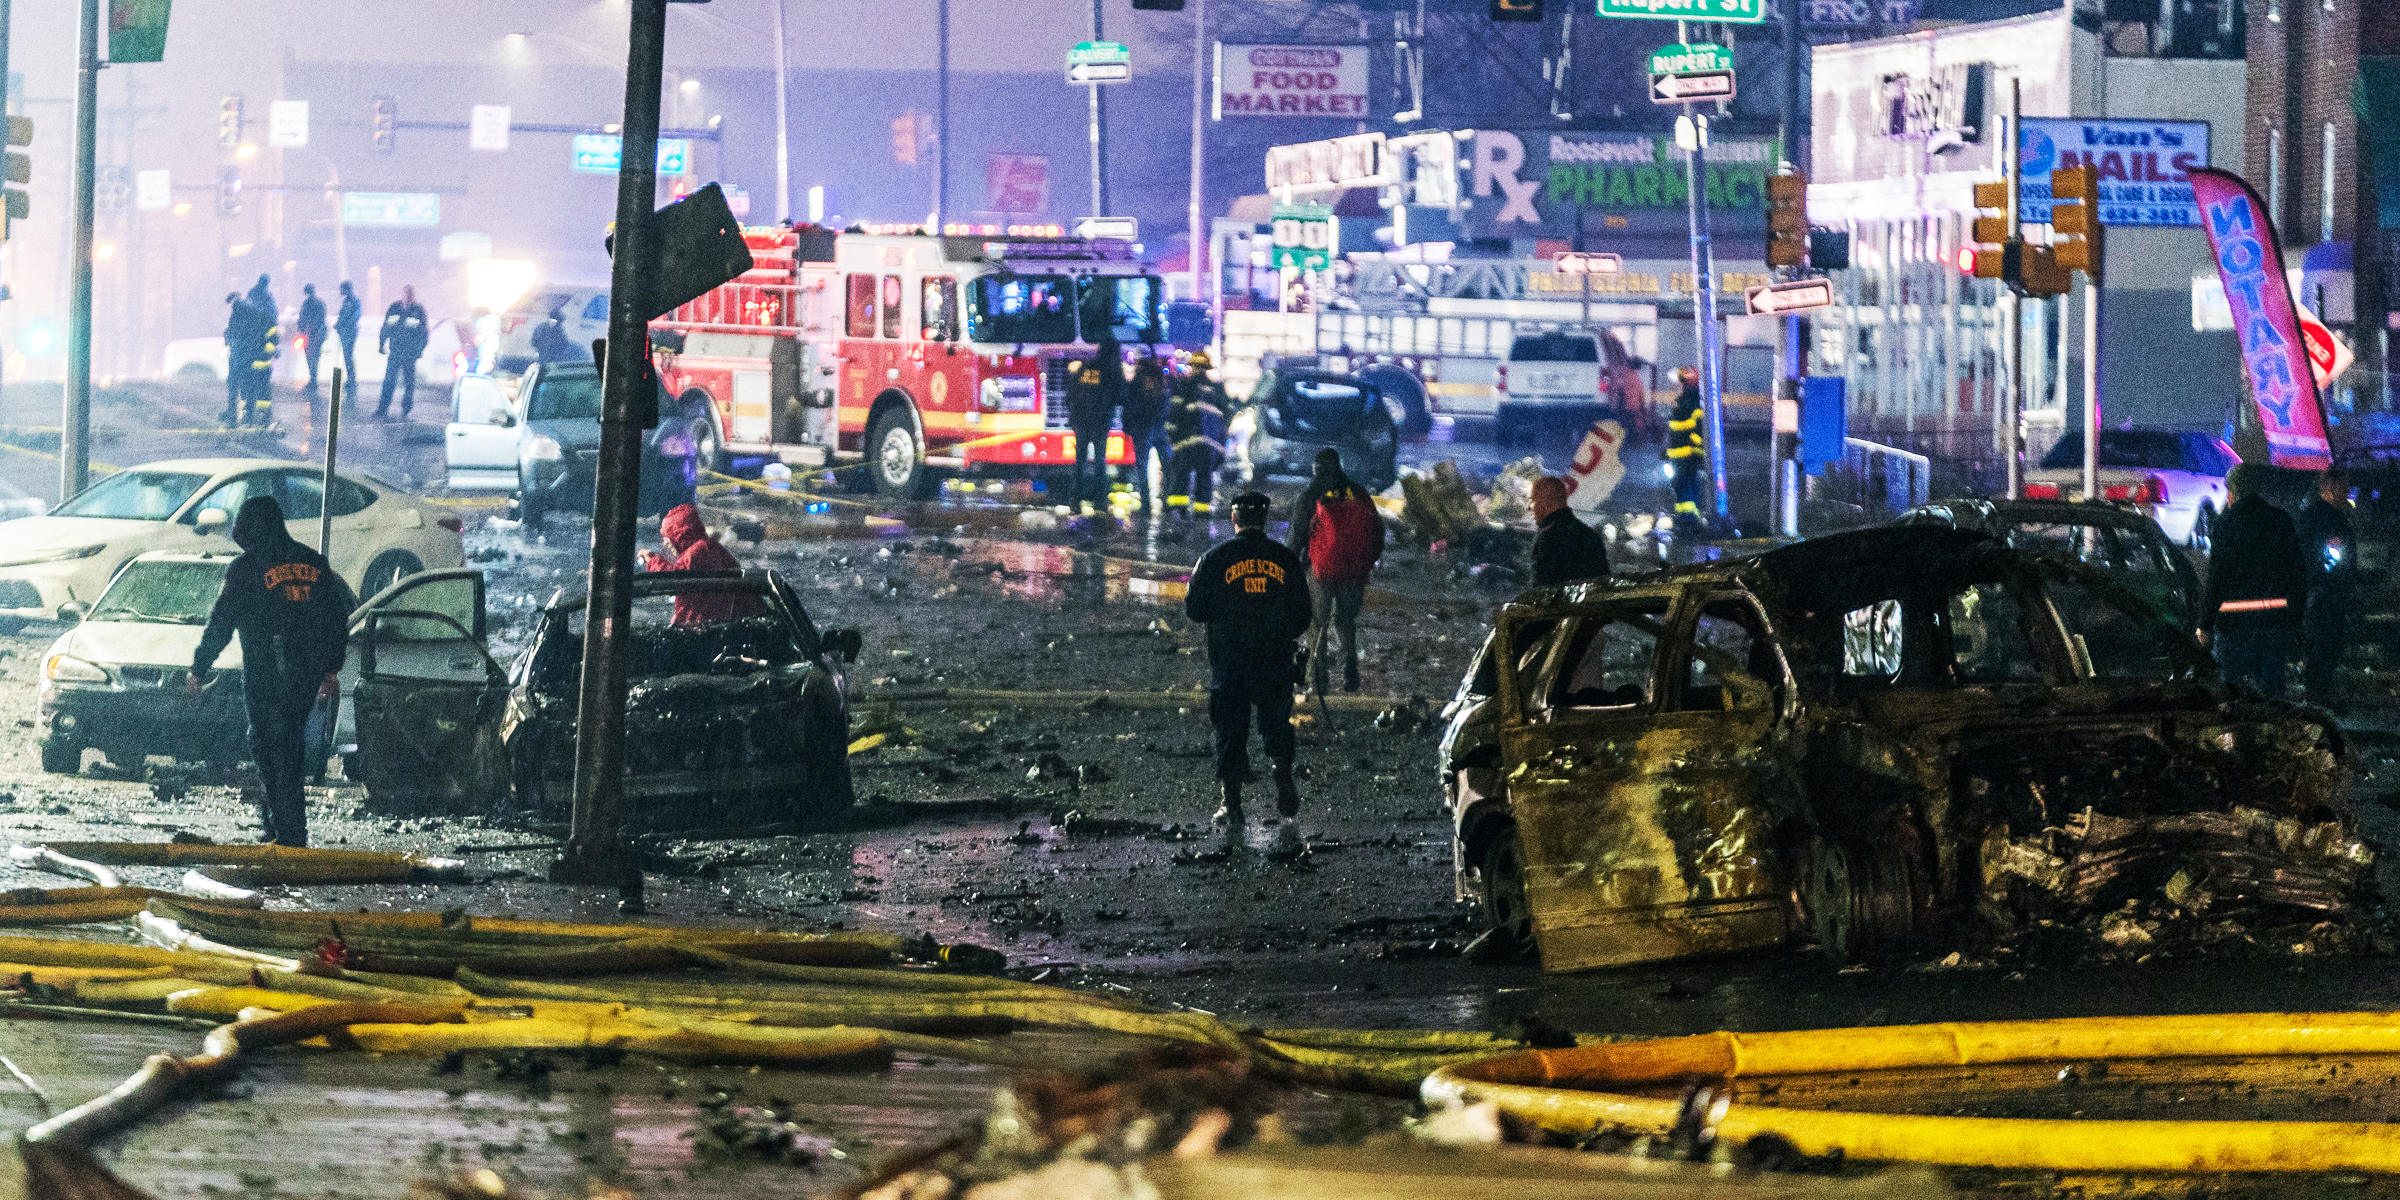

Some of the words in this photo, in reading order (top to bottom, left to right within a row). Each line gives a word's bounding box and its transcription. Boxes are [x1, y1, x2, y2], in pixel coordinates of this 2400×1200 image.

[1653, 52, 1716, 72] RUPERT
[1253, 71, 1338, 90] FOOD
[1222, 92, 1367, 113] MARKET
[2082, 126, 2183, 146] Van's
[1550, 135, 1654, 162] Roosevelt
[2060, 151, 2197, 182] NAILS
[1225, 559, 1256, 585] CRIME
[1257, 559, 1285, 585] SCENE
[1244, 577, 1267, 593] UNIT
